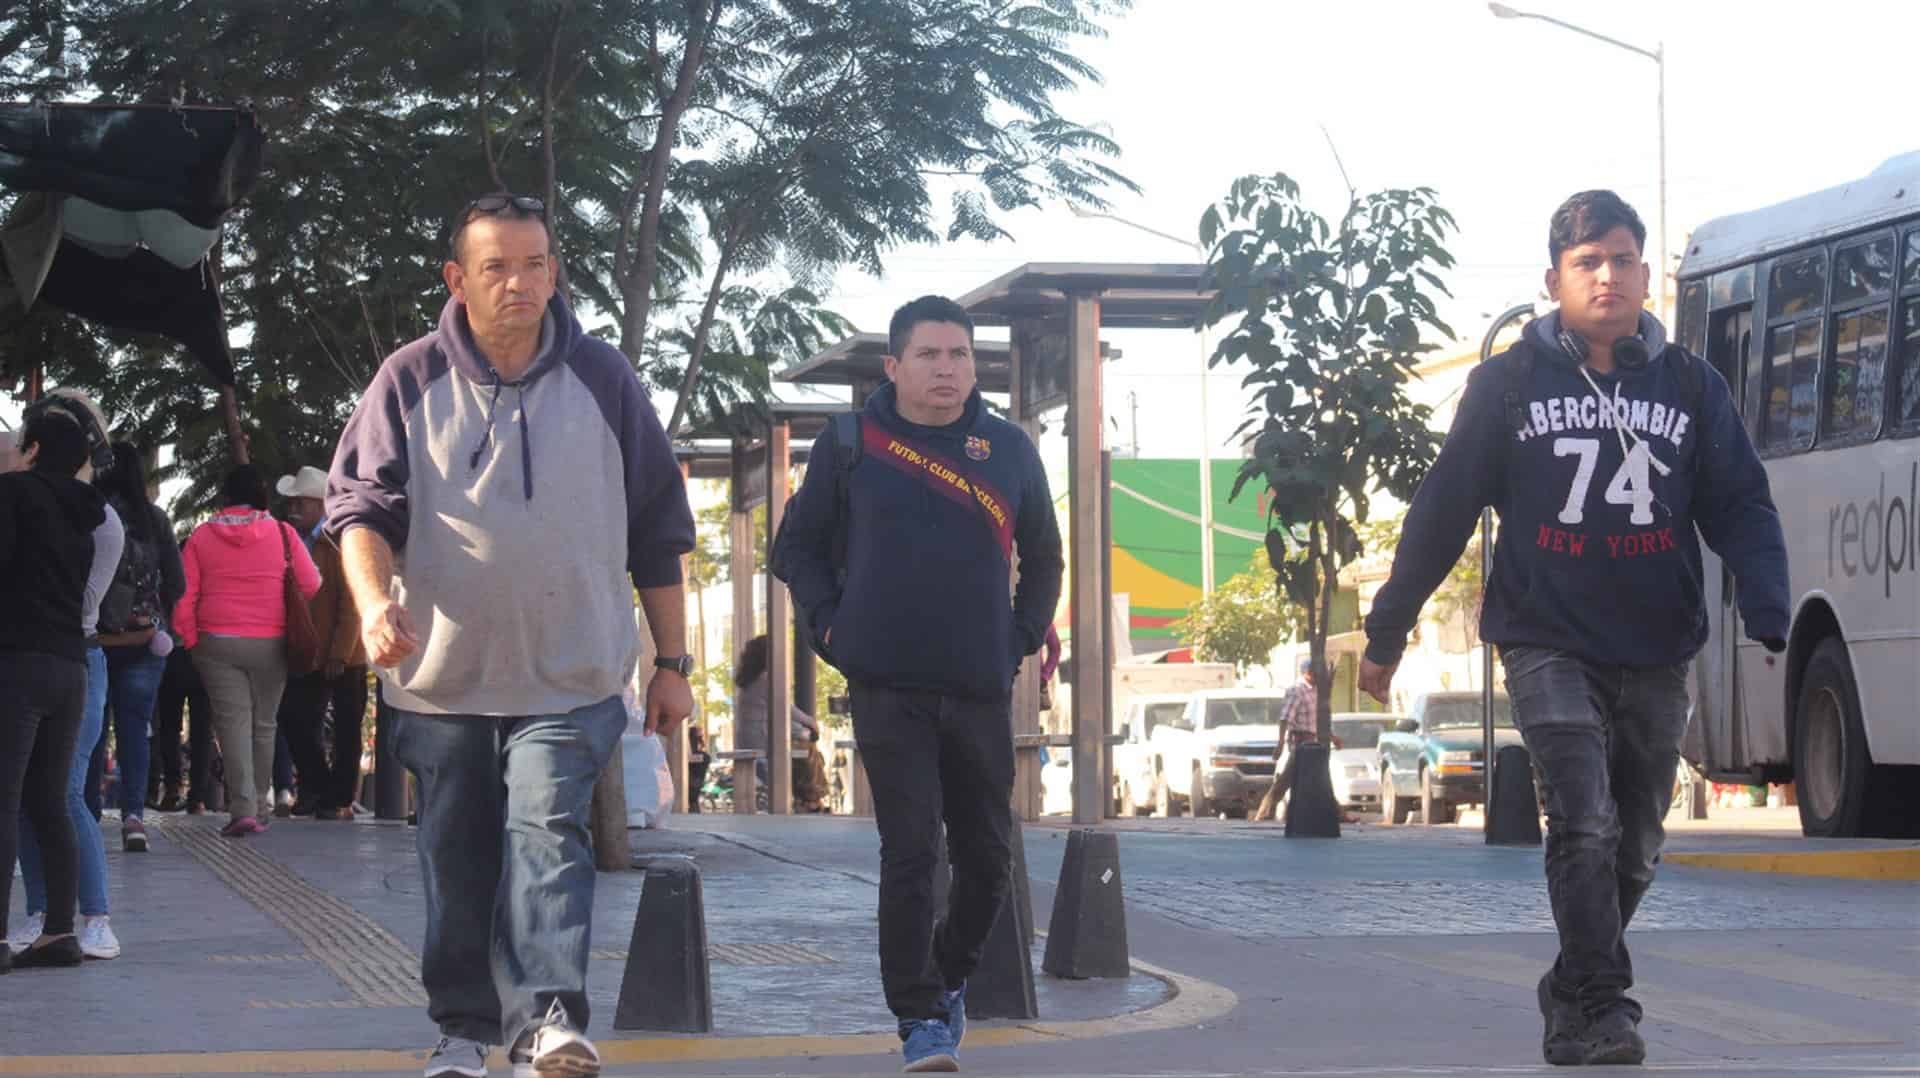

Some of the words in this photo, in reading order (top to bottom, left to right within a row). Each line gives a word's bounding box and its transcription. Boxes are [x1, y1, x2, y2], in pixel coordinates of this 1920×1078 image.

[928, 462, 958, 485] CLUB
[1553, 437, 1655, 526] 74
[1536, 524, 1586, 558] NEW
[1605, 527, 1676, 559] YORK
[1827, 461, 1920, 599] redpl
